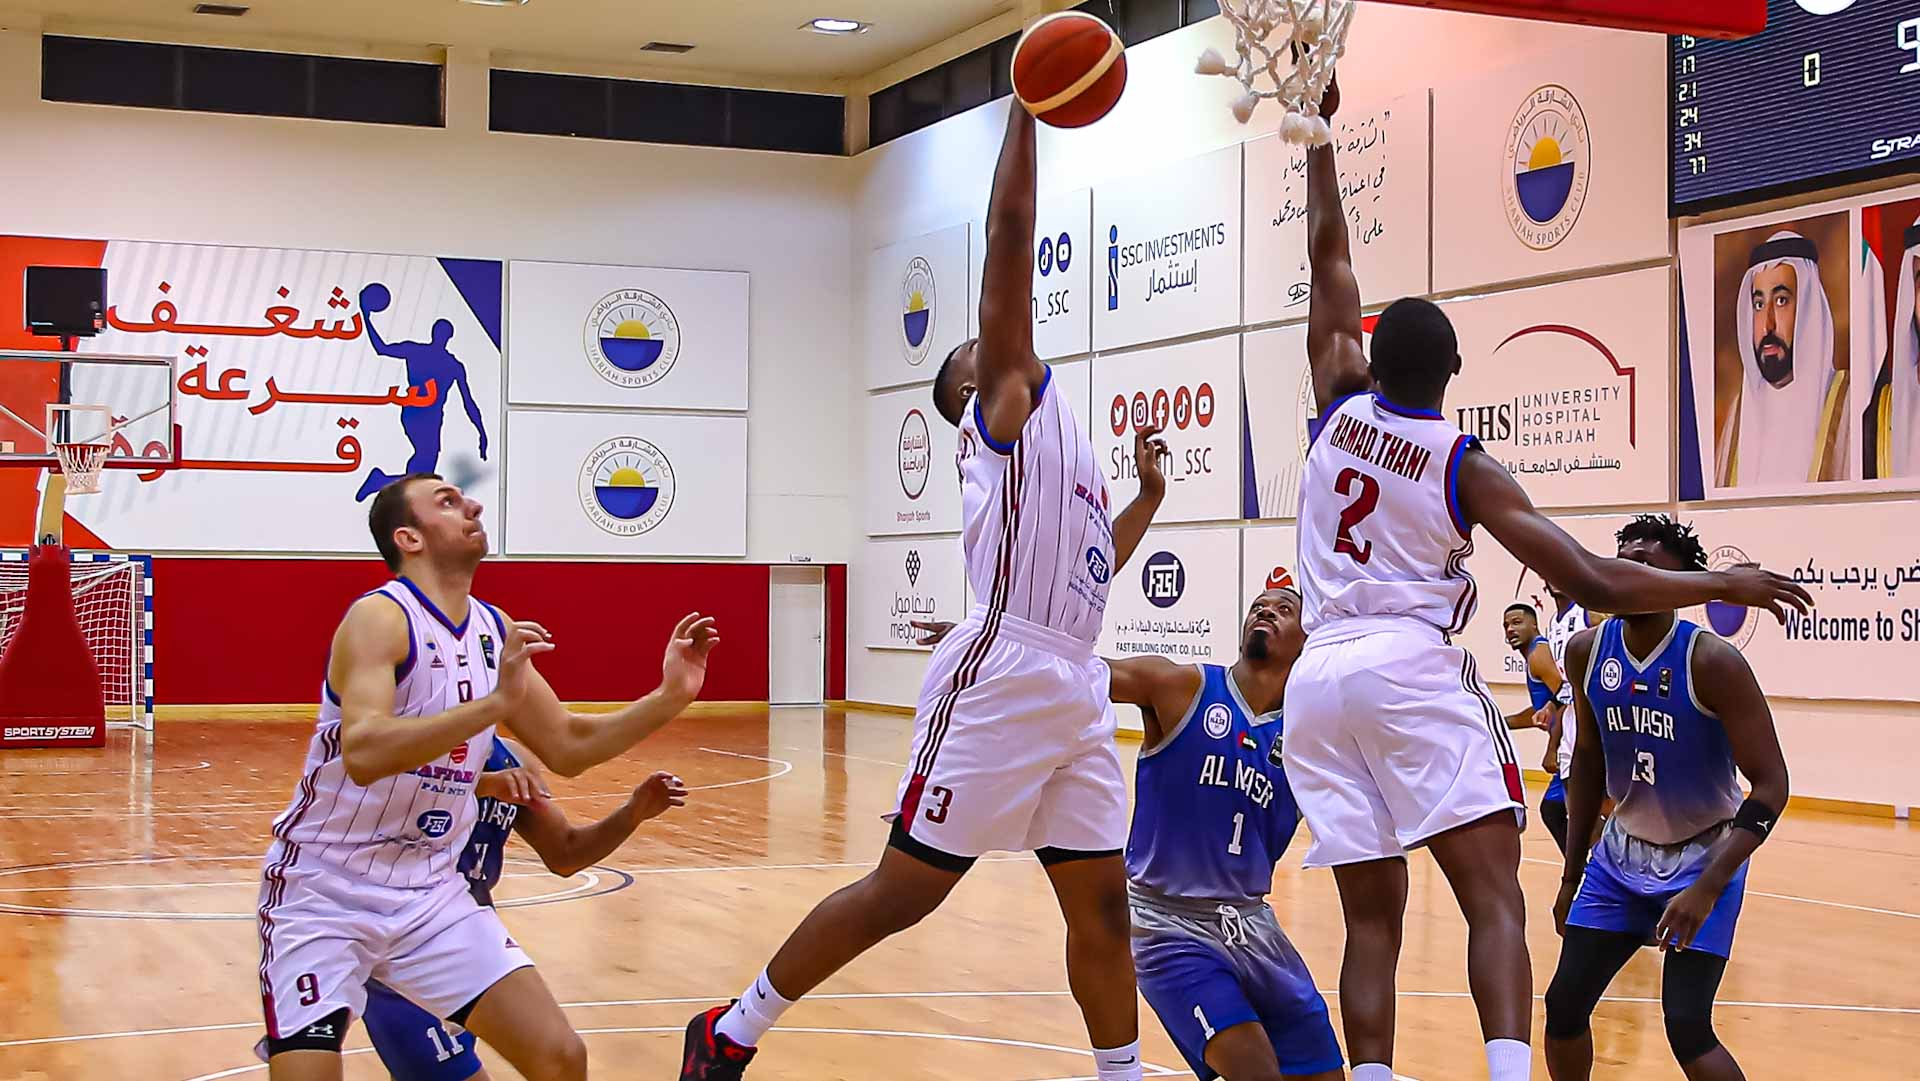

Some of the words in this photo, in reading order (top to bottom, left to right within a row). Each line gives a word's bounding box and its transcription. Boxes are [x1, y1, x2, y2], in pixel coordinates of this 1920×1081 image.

[1804, 52, 1820, 87] 0
[1678, 82, 1696, 101] 21
[1680, 107, 1698, 127] 24
[1684, 132, 1702, 152] 34
[1689, 156, 1706, 174] 77
[1507, 186, 1533, 241] SHARJAH
[1536, 217, 1570, 244] SPORTS
[1121, 243, 1143, 268] SSC
[1144, 222, 1225, 262] INVESTMENTS
[1145, 258, 1198, 302] إستثمار
[106, 280, 362, 340] شغف
[624, 292, 661, 309] الشارقة
[177, 345, 437, 415] سرعة
[591, 344, 618, 380] SHARJAH
[622, 370, 658, 384] SPORTS
[1457, 404, 1512, 441] UHS
[1522, 386, 1620, 408] UNIVERSITY
[1522, 408, 1600, 427] HOSPITAL
[620, 440, 656, 457] الشارقة
[1522, 428, 1596, 447] SHARJAH
[1519, 458, 1562, 476] الجامعة
[585, 493, 614, 530] SHARJAH
[617, 518, 654, 532] SPORTS
[1334, 467, 1380, 565] 2
[1830, 565, 1877, 590] يرحب
[1784, 608, 1870, 640] Welcome
[1876, 611, 1894, 641] to
[1116, 642, 1130, 652] FAST
[1132, 642, 1159, 654] BUILDING
[4, 726, 95, 739] SPORTSYSTEM
[1607, 706, 1630, 731] AL
[1199, 755, 1228, 786] AL
[926, 786, 953, 824] 3
[1228, 812, 1244, 855] 1
[296, 973, 320, 1006] 9
[1194, 1005, 1216, 1040] 1
[427, 1026, 464, 1062] 11
